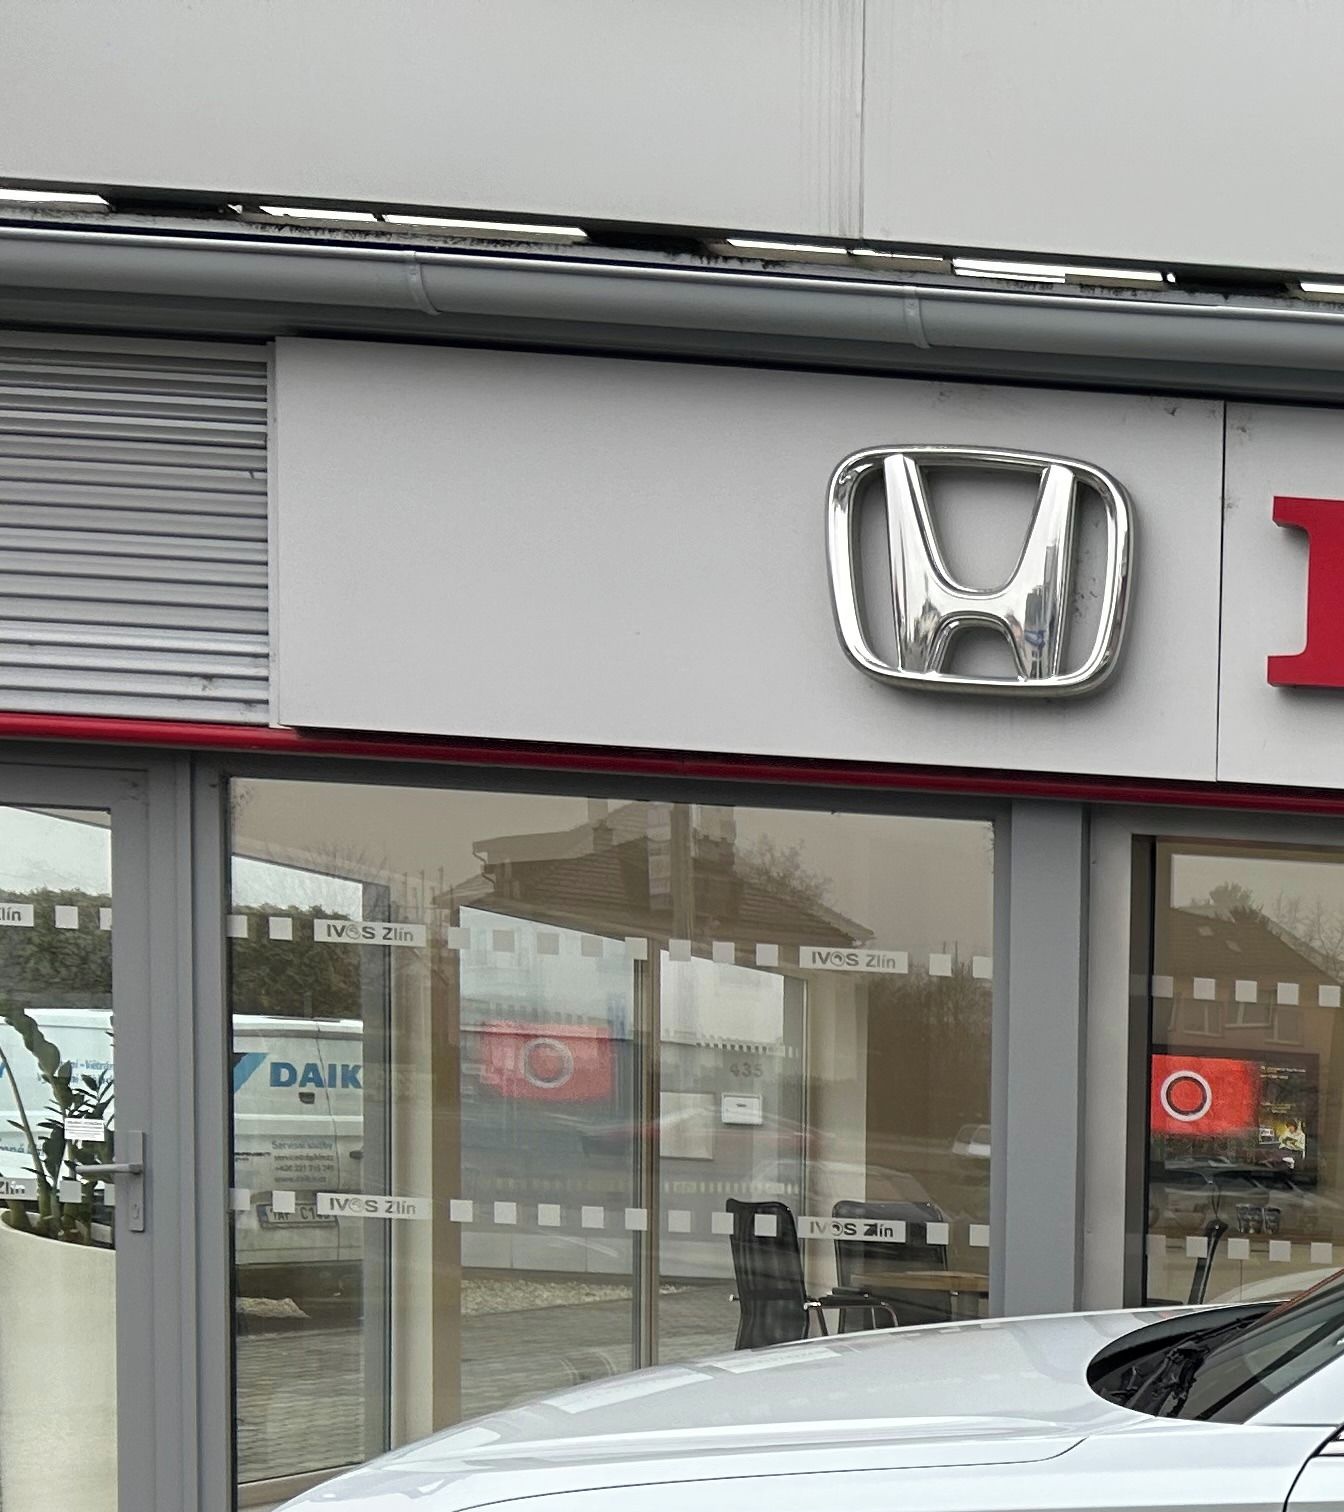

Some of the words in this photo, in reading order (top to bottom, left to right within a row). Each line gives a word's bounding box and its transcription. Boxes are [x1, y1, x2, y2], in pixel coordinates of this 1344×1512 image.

[382, 926, 414, 942] Zlín
[865, 953, 896, 969] Zlín
[270, 1061, 363, 1089] DAIK
[384, 1200, 416, 1215] Zlín
[863, 1222, 893, 1237] Zlín
